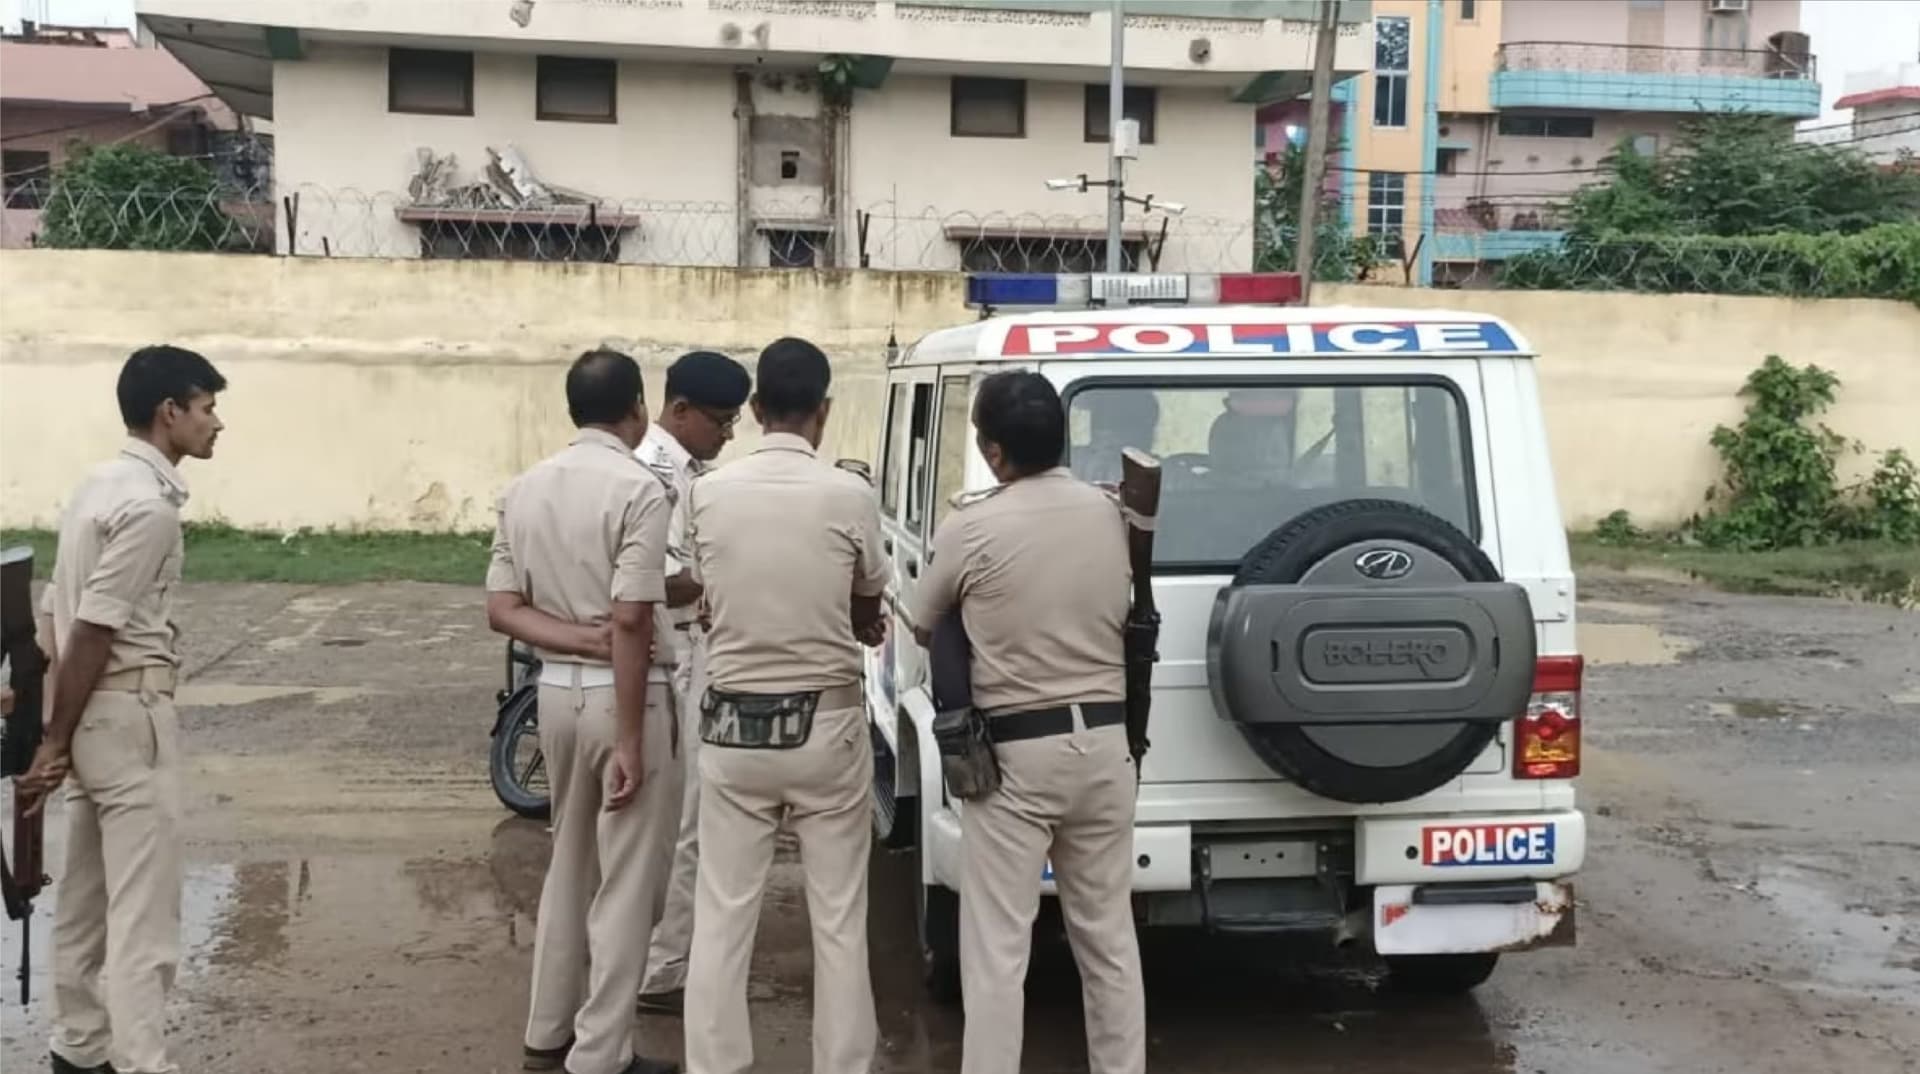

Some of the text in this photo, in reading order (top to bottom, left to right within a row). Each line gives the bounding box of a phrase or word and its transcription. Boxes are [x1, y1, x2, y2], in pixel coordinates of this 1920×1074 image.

[1026, 323, 1490, 353] POLICE
[1323, 639, 1448, 676] BOLERO
[1431, 827, 1546, 864] POLICE
